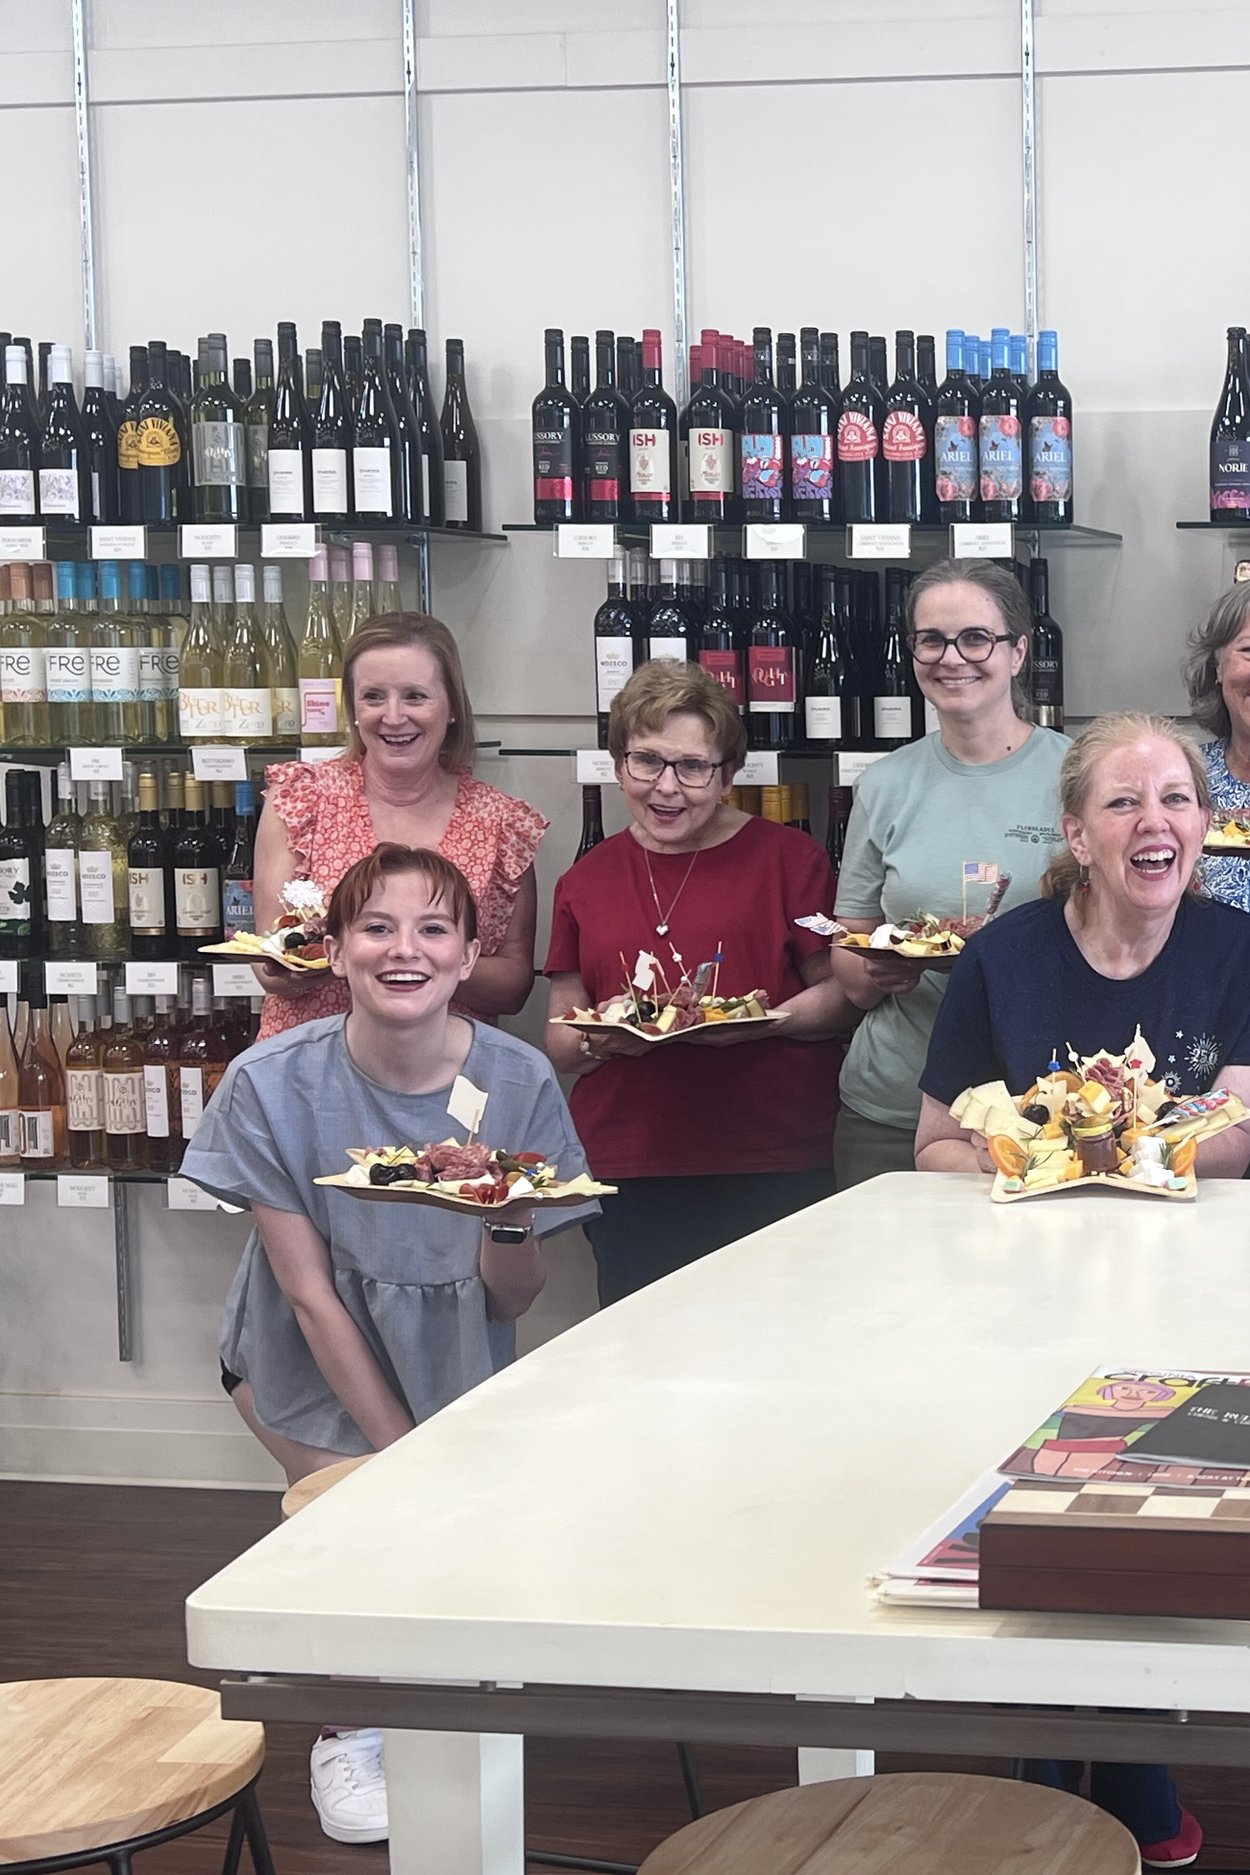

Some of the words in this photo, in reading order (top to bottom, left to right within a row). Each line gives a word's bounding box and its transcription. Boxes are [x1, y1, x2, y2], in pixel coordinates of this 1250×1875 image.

[633, 433, 656, 446] ISH
[698, 433, 724, 446] ISH
[941, 451, 972, 462] ARIEL
[983, 450, 1015, 462] ARIEL
[1034, 451, 1066, 462] ARIEL
[1218, 463, 1249, 473] NORIE
[1190, 1406, 1218, 1414] THE
